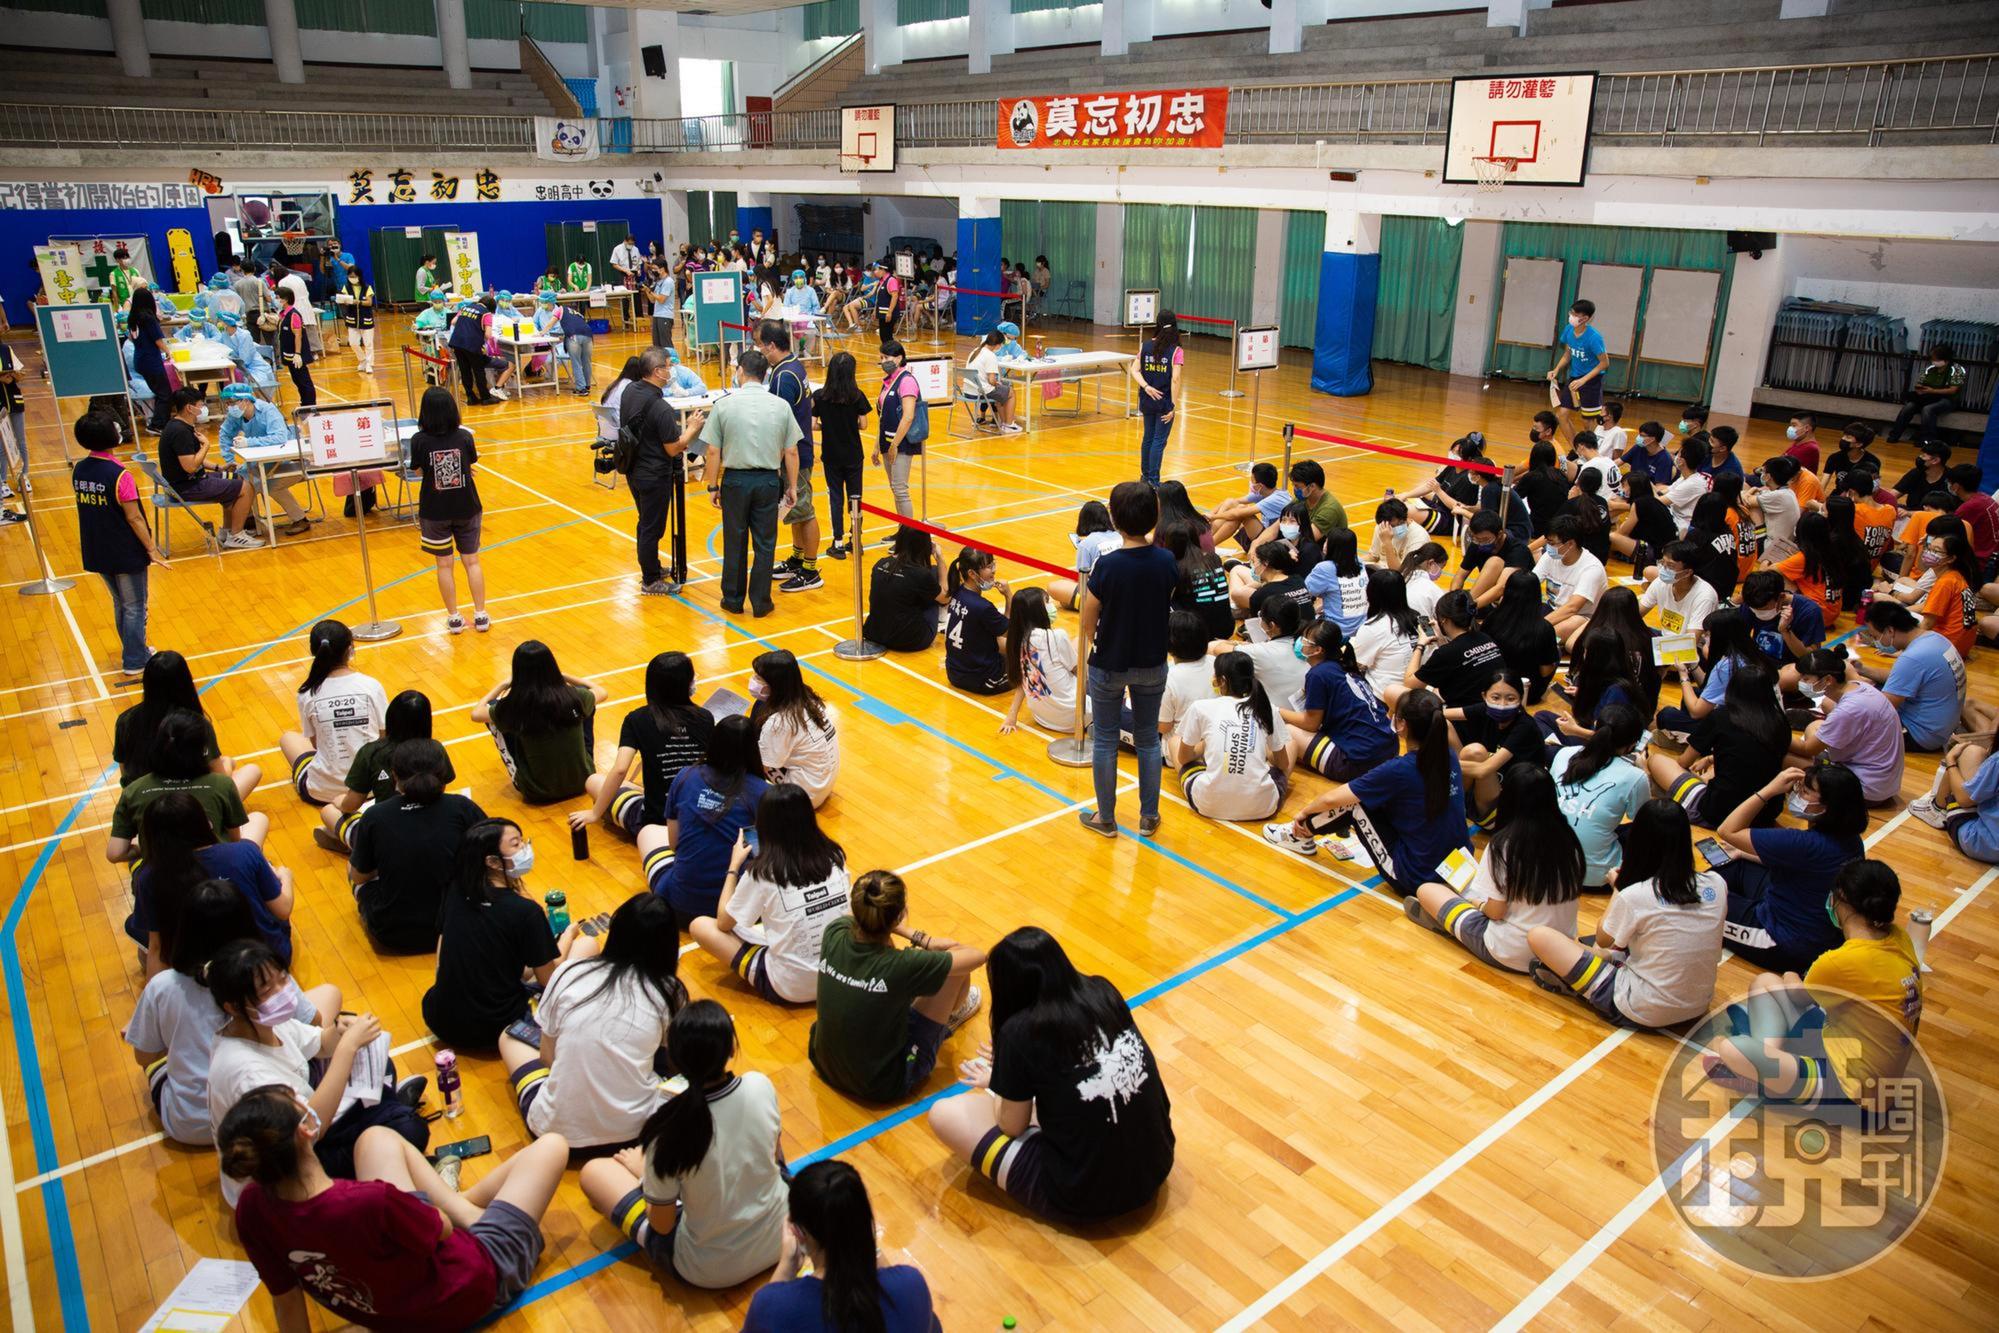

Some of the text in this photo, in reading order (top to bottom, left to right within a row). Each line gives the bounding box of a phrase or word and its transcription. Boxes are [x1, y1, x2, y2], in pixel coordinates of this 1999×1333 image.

[1488, 79, 1557, 99] 請勿灌籃
[1045, 92, 1205, 137] 莫忘初忠
[349, 168, 500, 203] 莫忘初忠
[535, 184, 583, 200] 忠明高中
[322, 420, 338, 459] 注射區
[356, 416, 374, 448] 第三
[328, 698, 355, 708] 20:20
[1228, 733, 1240, 774] SPORTS
[805, 887, 828, 900] Taipei
[826, 965, 836, 977] We
[835, 972, 847, 984] are
